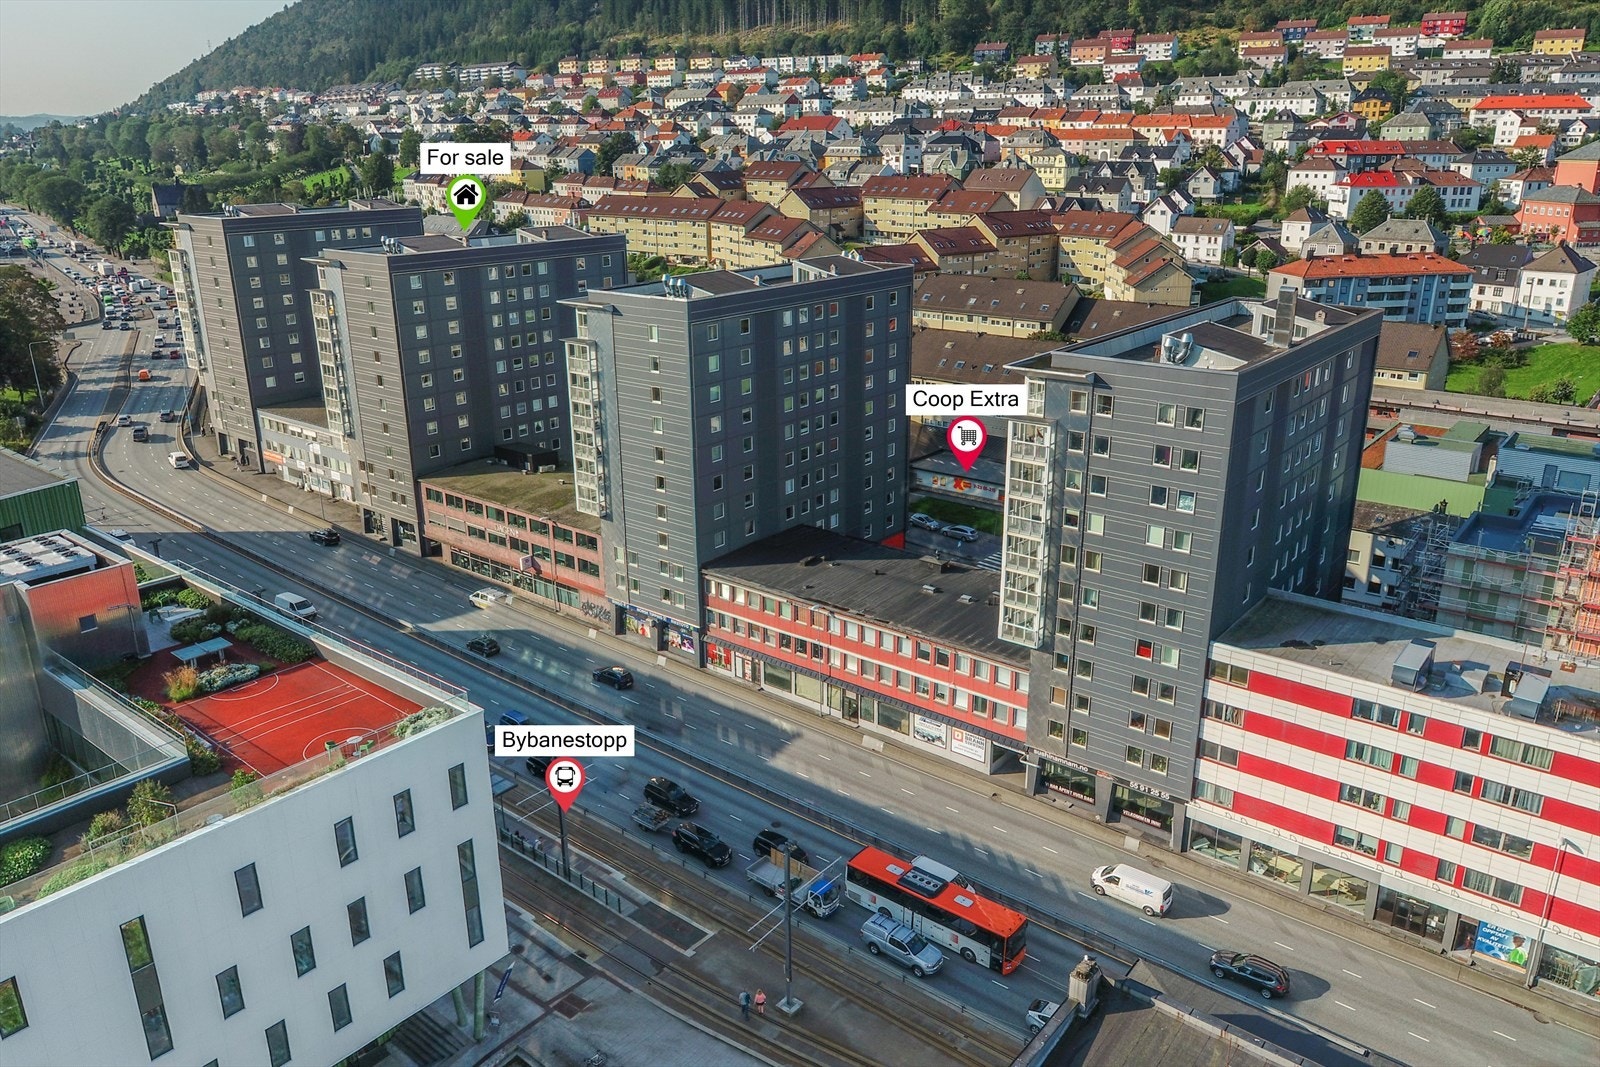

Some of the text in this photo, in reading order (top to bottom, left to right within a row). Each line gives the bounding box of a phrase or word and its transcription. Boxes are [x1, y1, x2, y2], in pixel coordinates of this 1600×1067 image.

[1033, 749, 1089, 772] sushinamnam.no
[1129, 780, 1170, 800] 55 91 25 55
[1482, 927, 1510, 940] OPPTATT
